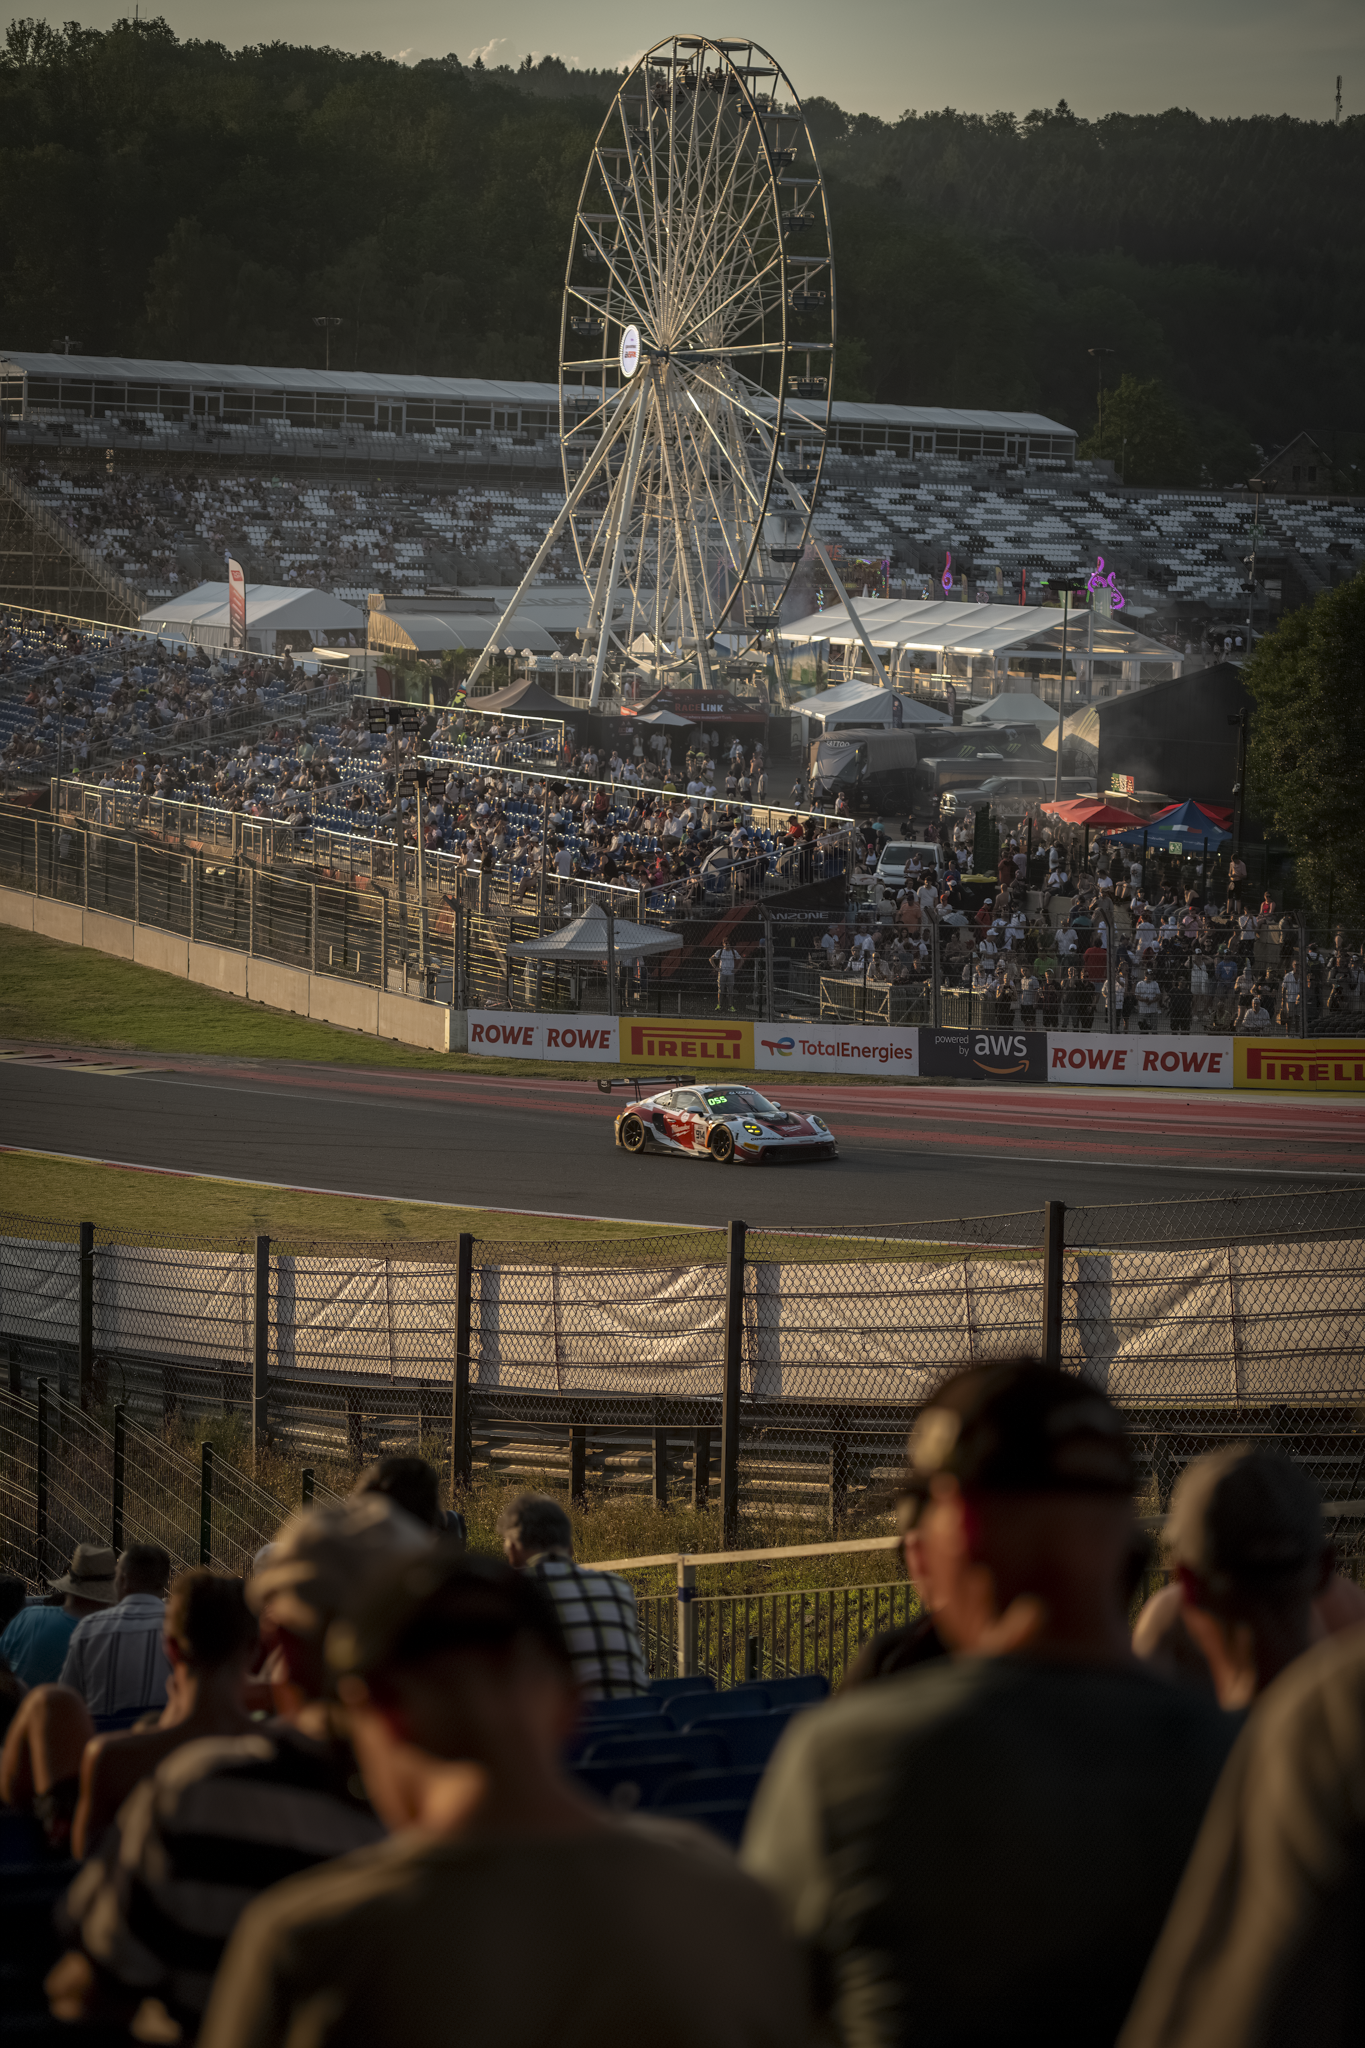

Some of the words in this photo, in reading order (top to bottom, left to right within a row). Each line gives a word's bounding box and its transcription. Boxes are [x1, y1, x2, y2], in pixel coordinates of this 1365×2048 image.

[674, 702, 724, 712] RACELINK
[471, 1023, 535, 1046] ROWE
[546, 1028, 612, 1049] ROWE
[631, 1026, 743, 1060] PIRELLI
[935, 1035, 969, 1046] powered
[974, 1034, 1027, 1057] aws
[798, 1040, 913, 1063] TotalEnergies
[958, 1046, 969, 1056] by
[1052, 1047, 1128, 1071] ROWE
[1142, 1050, 1224, 1073] ROWE
